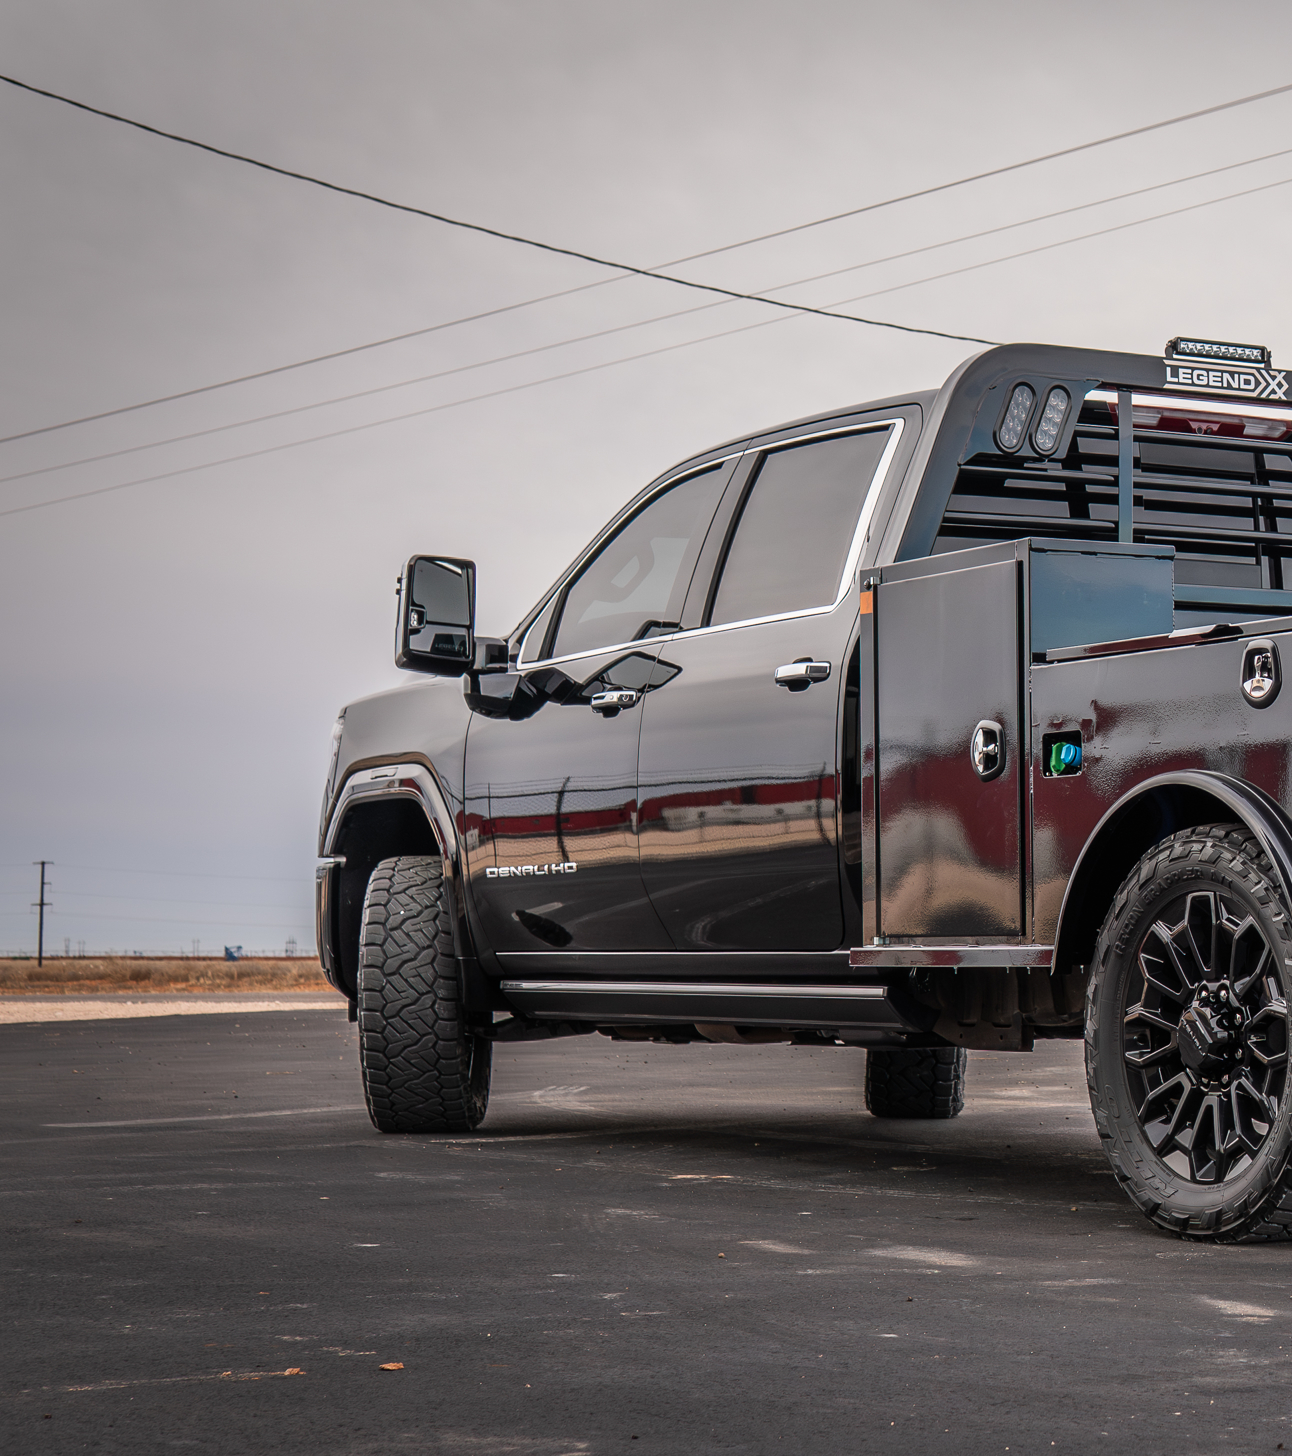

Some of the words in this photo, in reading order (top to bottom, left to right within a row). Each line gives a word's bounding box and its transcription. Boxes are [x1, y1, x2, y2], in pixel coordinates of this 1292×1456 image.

[1166, 366, 1255, 390] LEGEND
[486, 864, 549, 878] DENALI
[551, 862, 578, 874] HD
